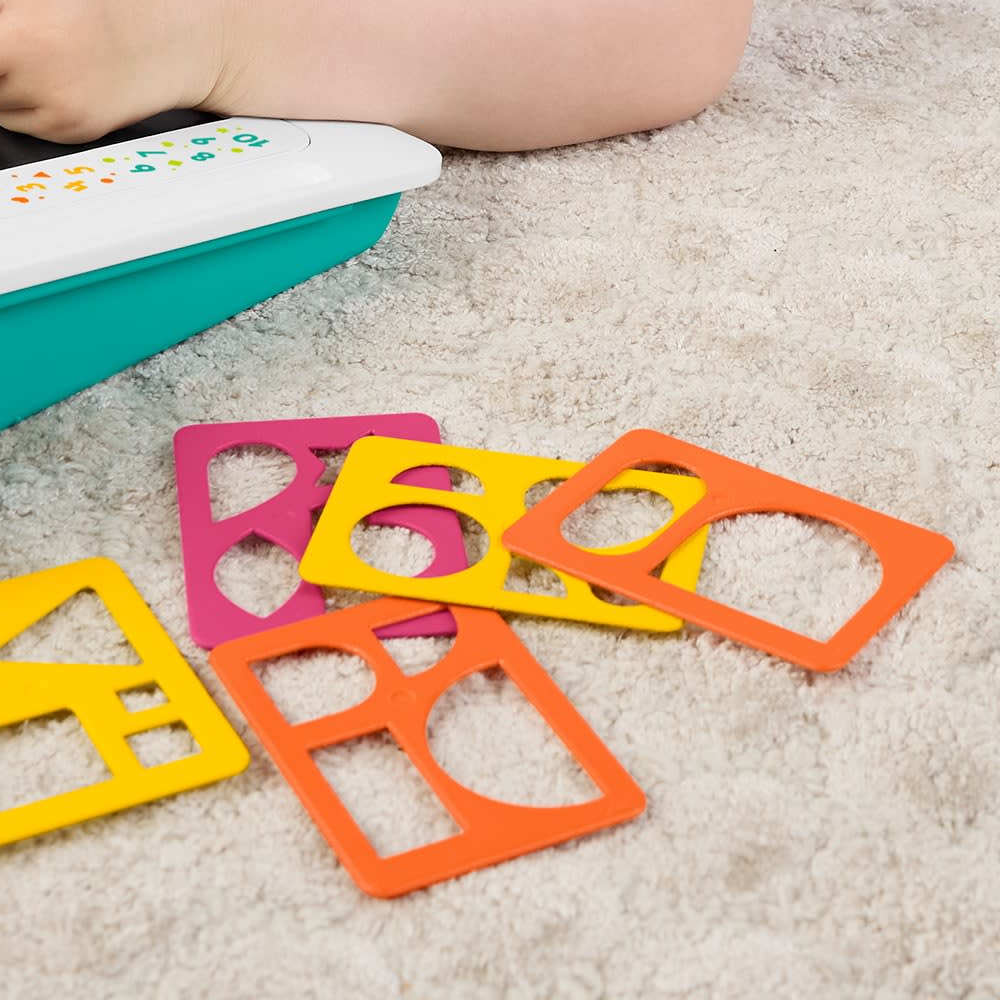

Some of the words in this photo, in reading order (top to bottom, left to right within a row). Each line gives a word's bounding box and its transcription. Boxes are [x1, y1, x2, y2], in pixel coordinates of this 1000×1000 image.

[190, 136, 216, 146] 9
[232, 133, 269, 148] 10
[135, 150, 167, 158] 7
[190, 151, 216, 162] 8
[62, 165, 95, 176] 5
[129, 163, 156, 174] 6
[15, 182, 47, 193] 3
[63, 179, 89, 192] 4
